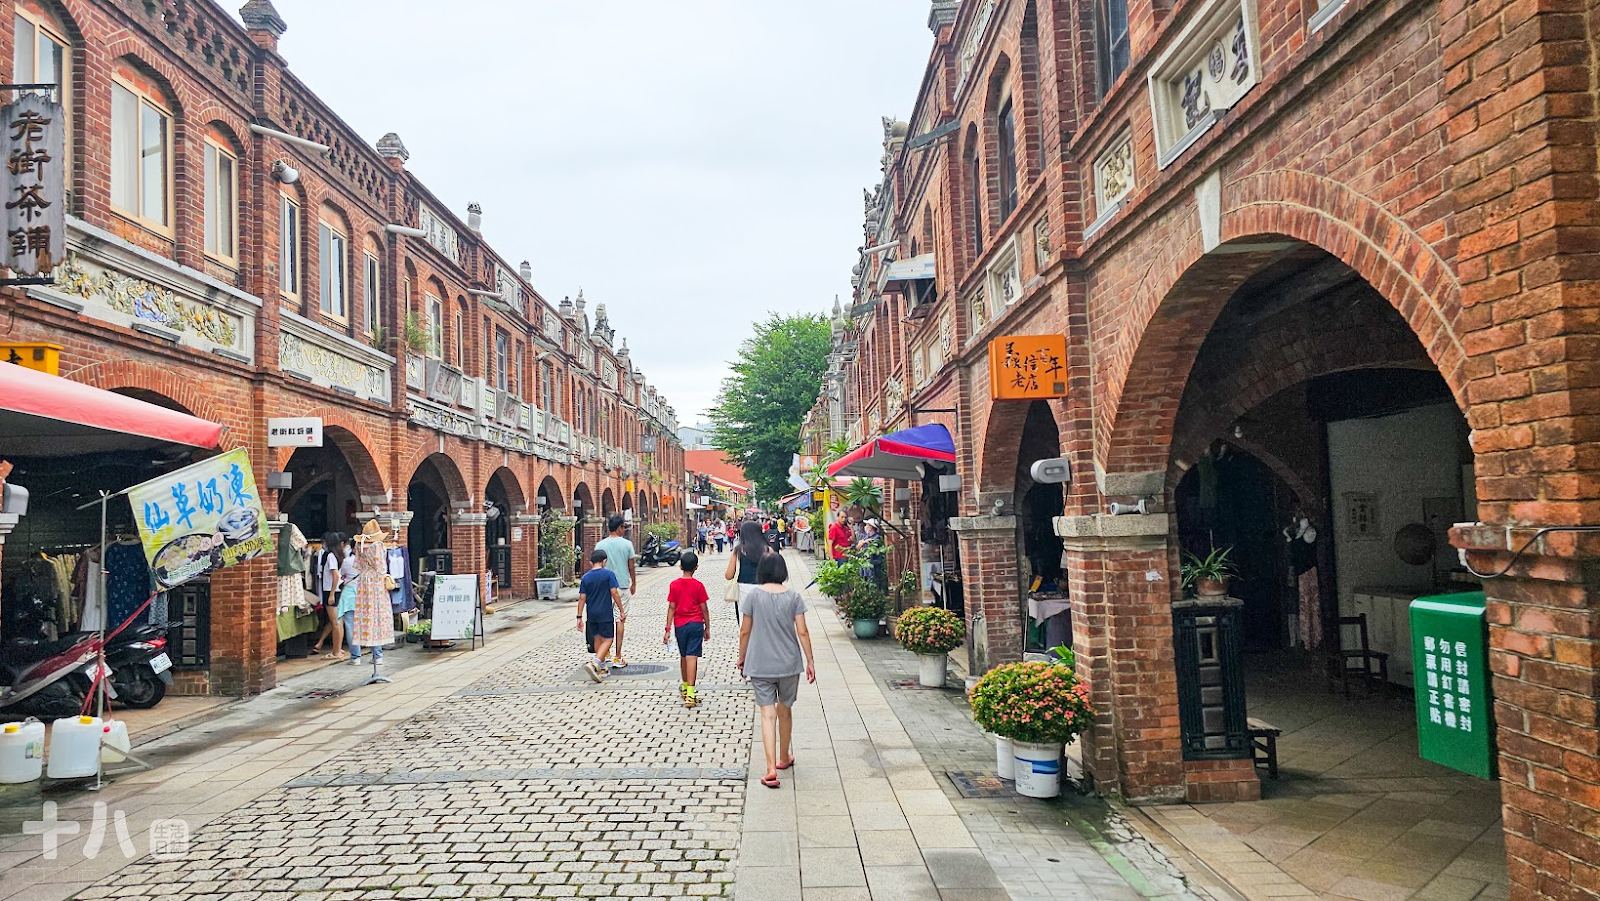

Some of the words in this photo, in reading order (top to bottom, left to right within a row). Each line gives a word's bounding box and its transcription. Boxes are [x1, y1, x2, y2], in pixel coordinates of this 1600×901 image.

[6, 109, 52, 258] 老街茶舖
[1010, 371, 1039, 393] 老店
[144, 463, 253, 534] 仙草奶凍
[1454, 641, 1471, 732] 信封請密封
